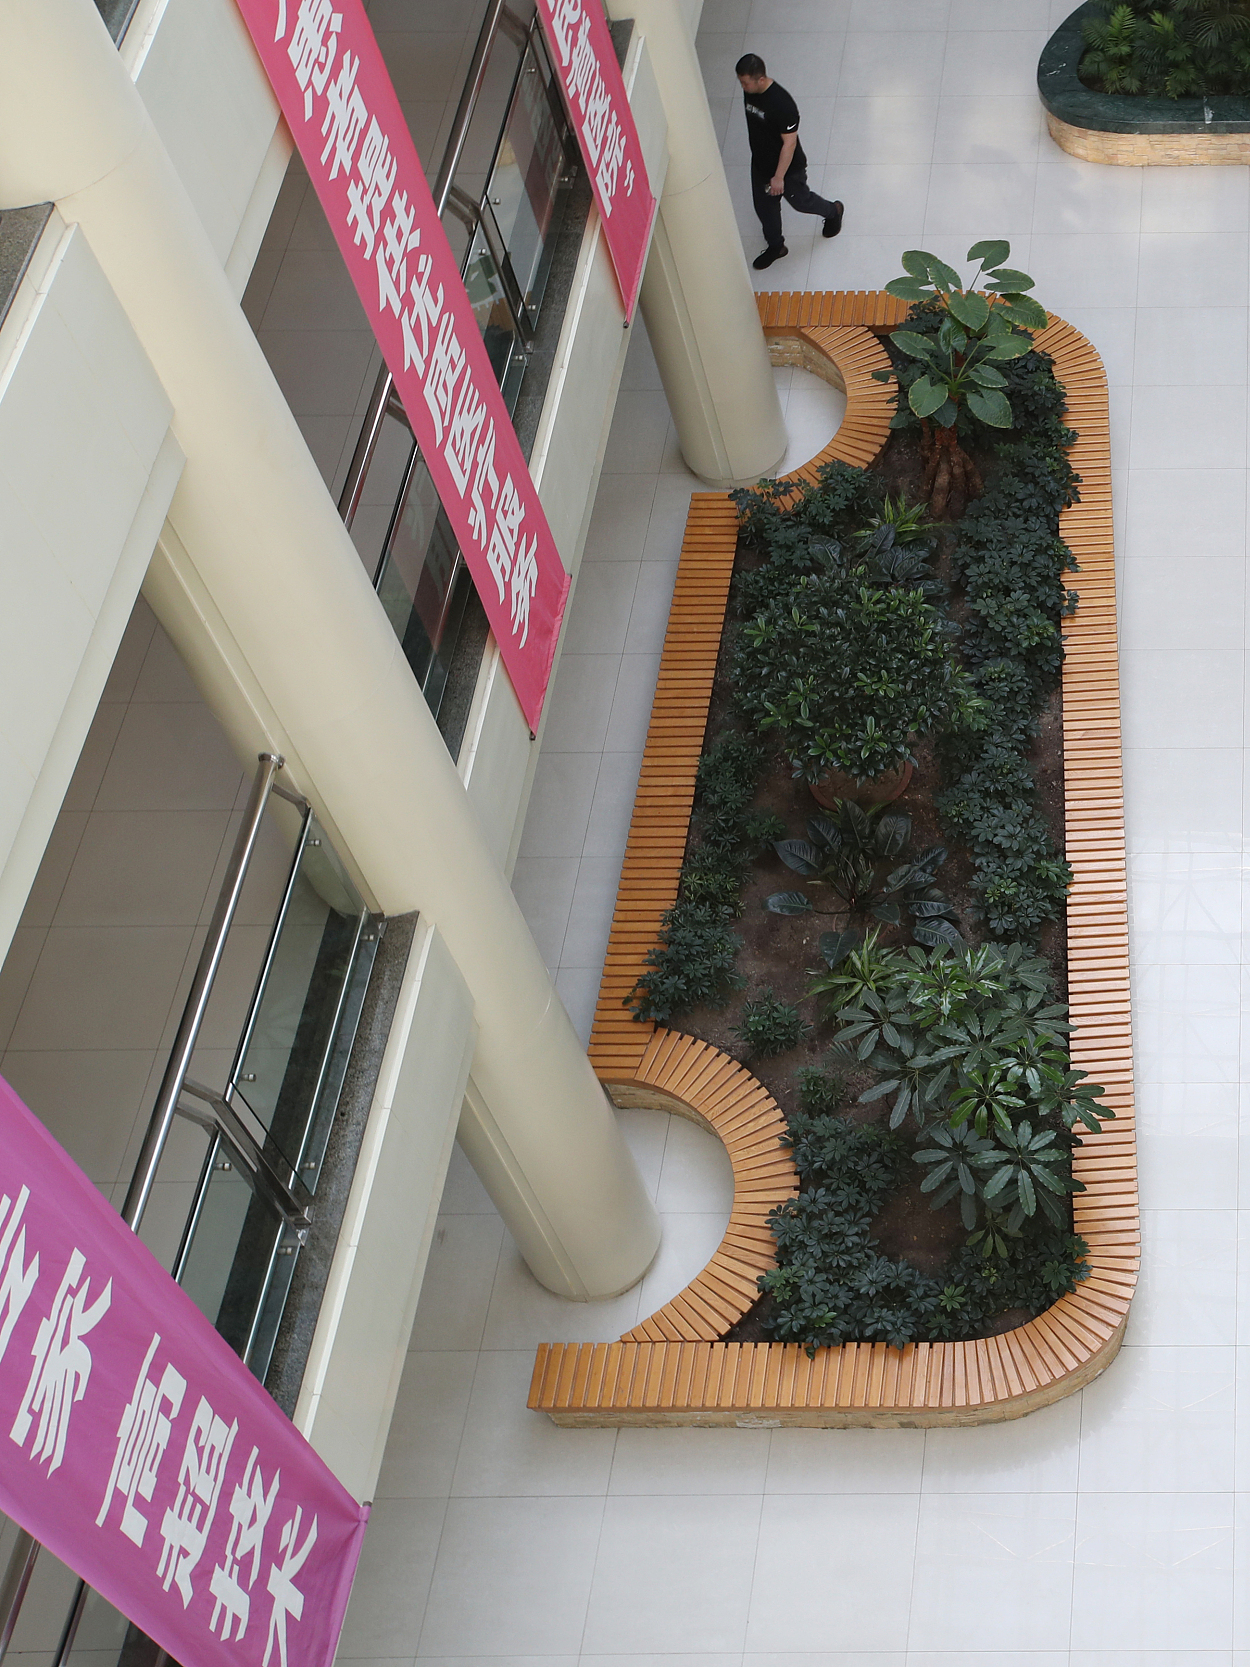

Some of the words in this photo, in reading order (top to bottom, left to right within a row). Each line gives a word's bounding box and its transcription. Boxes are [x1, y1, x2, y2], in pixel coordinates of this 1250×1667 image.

[547, 0, 635, 218] 民营医院”
[274, 0, 538, 650] 患者提供优质医疗服务
[95, 1332, 319, 1667] 高超技术
